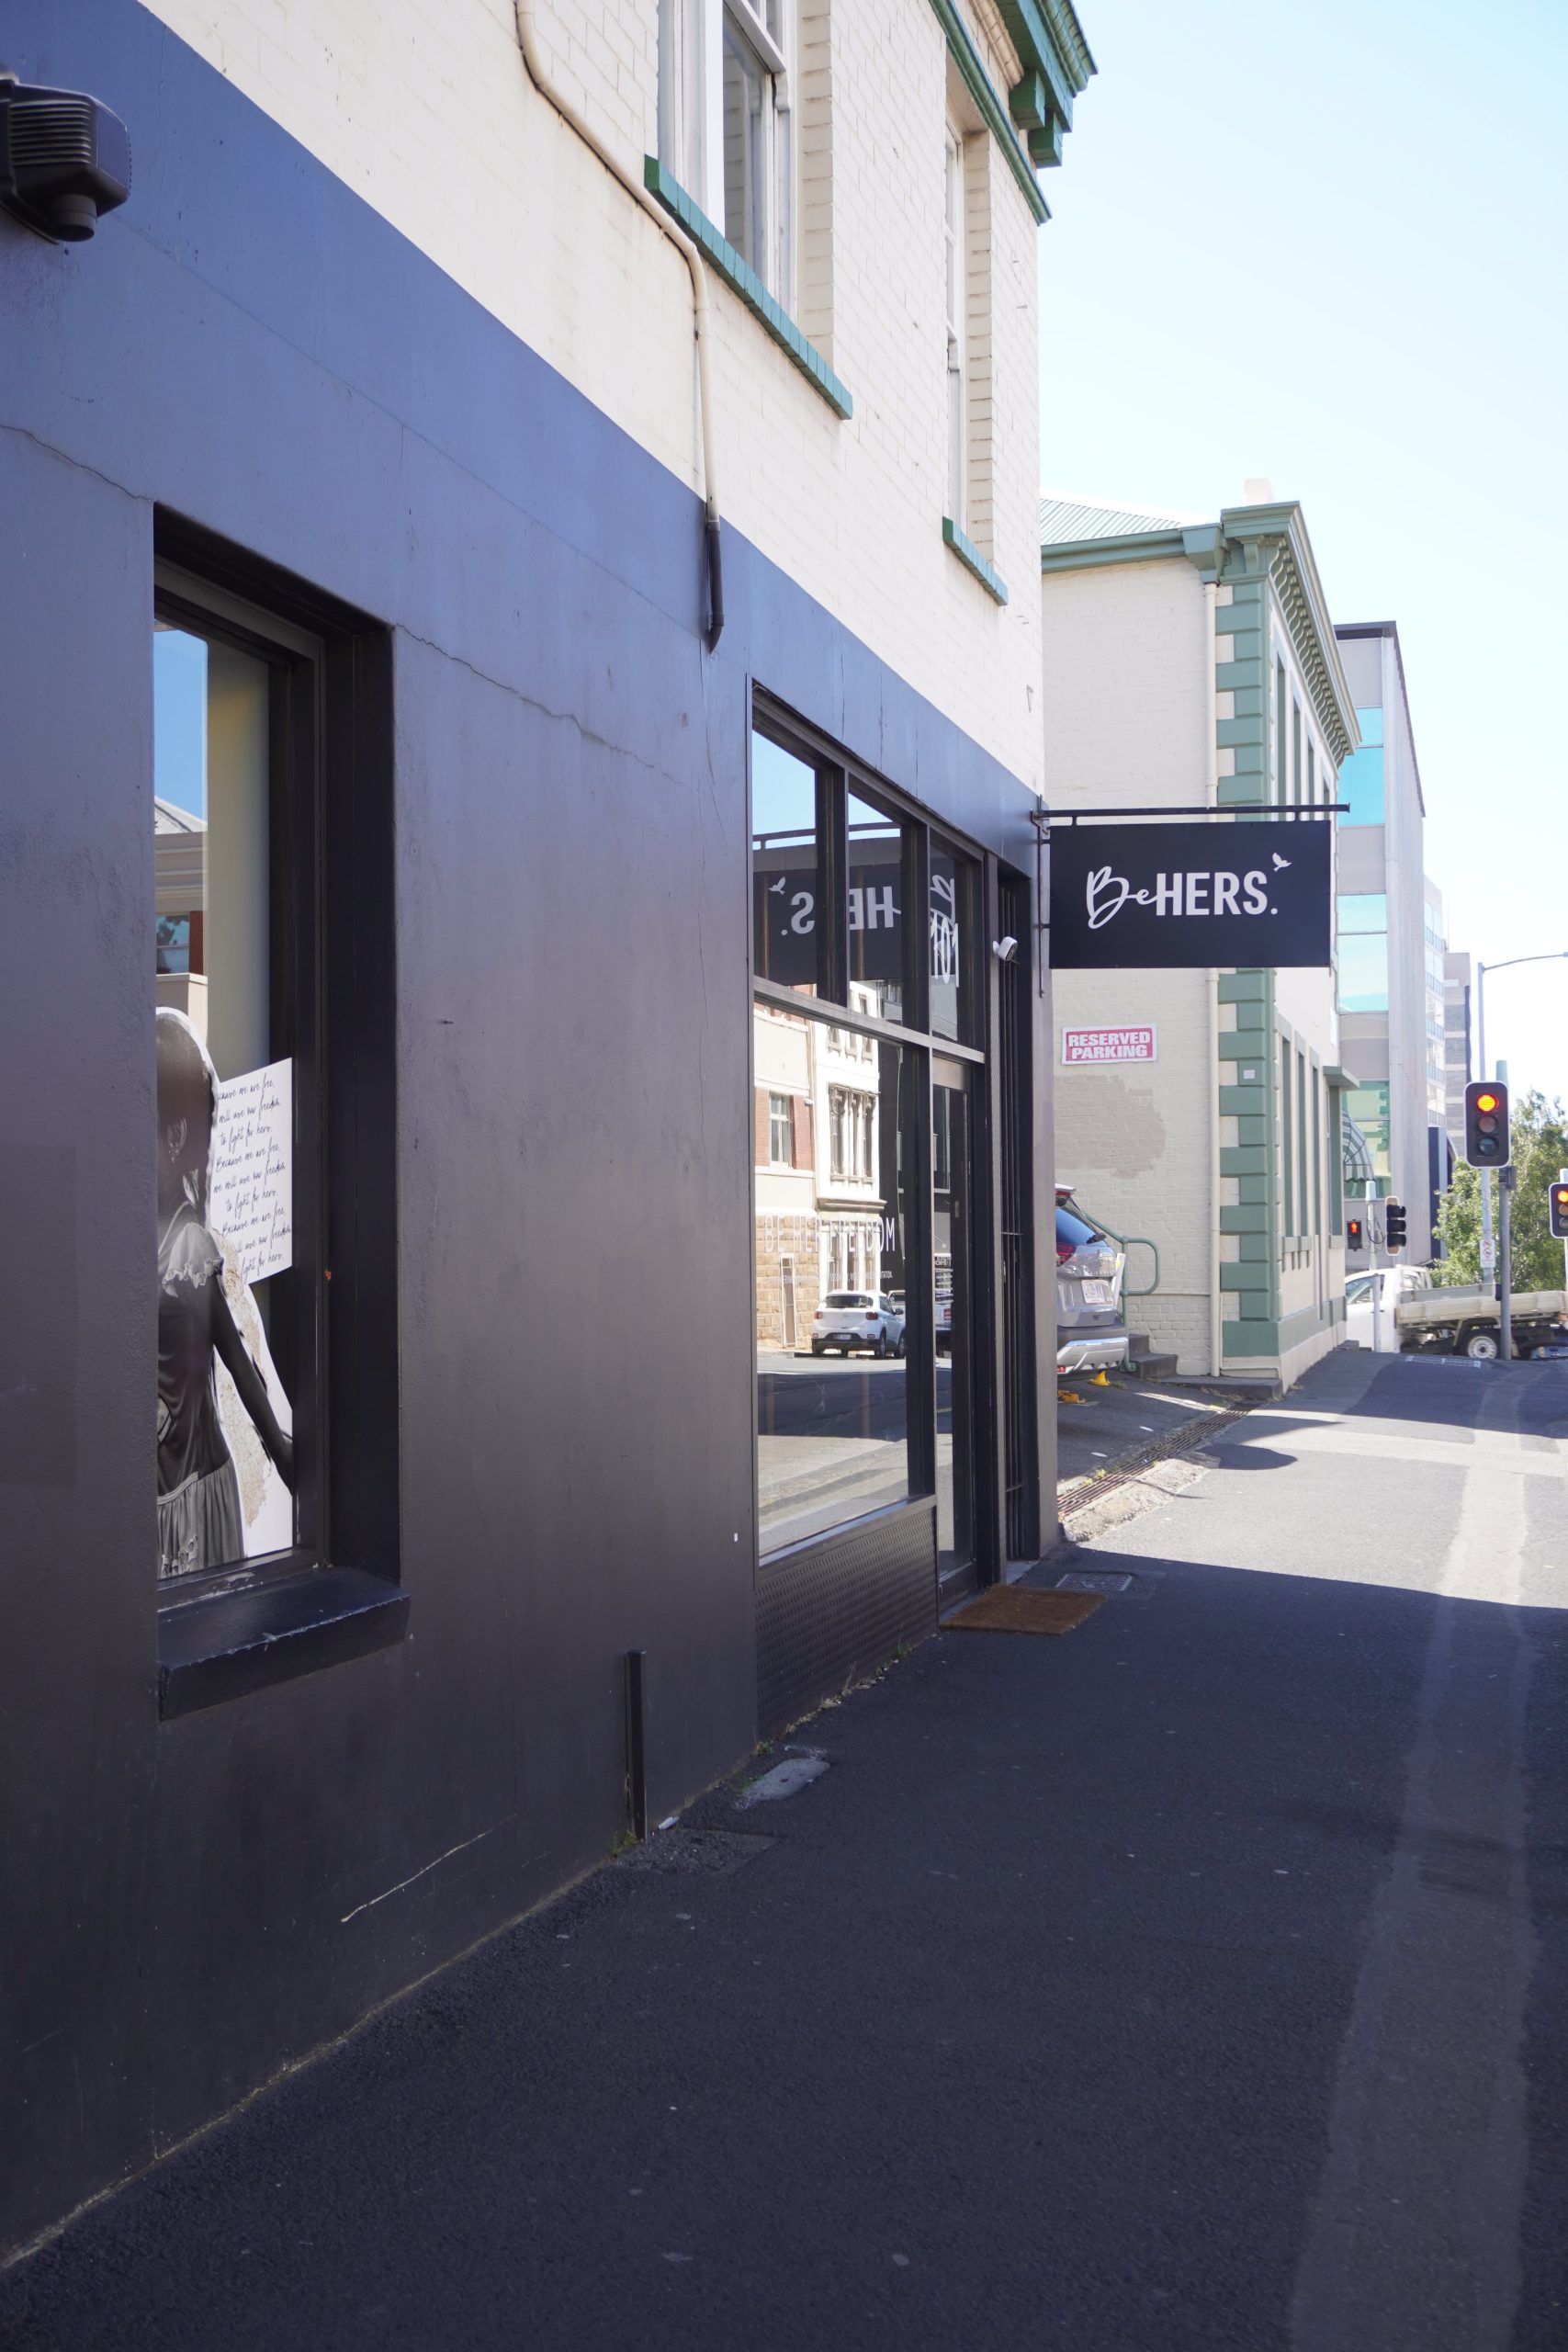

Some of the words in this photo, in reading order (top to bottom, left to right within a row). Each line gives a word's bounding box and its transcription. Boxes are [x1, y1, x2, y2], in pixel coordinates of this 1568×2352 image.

[931, 911, 959, 988] 101
[1068, 1031, 1151, 1046] RESERVED
[1072, 1045, 1147, 1058] PARKING
[765, 1214, 785, 1253] BE
